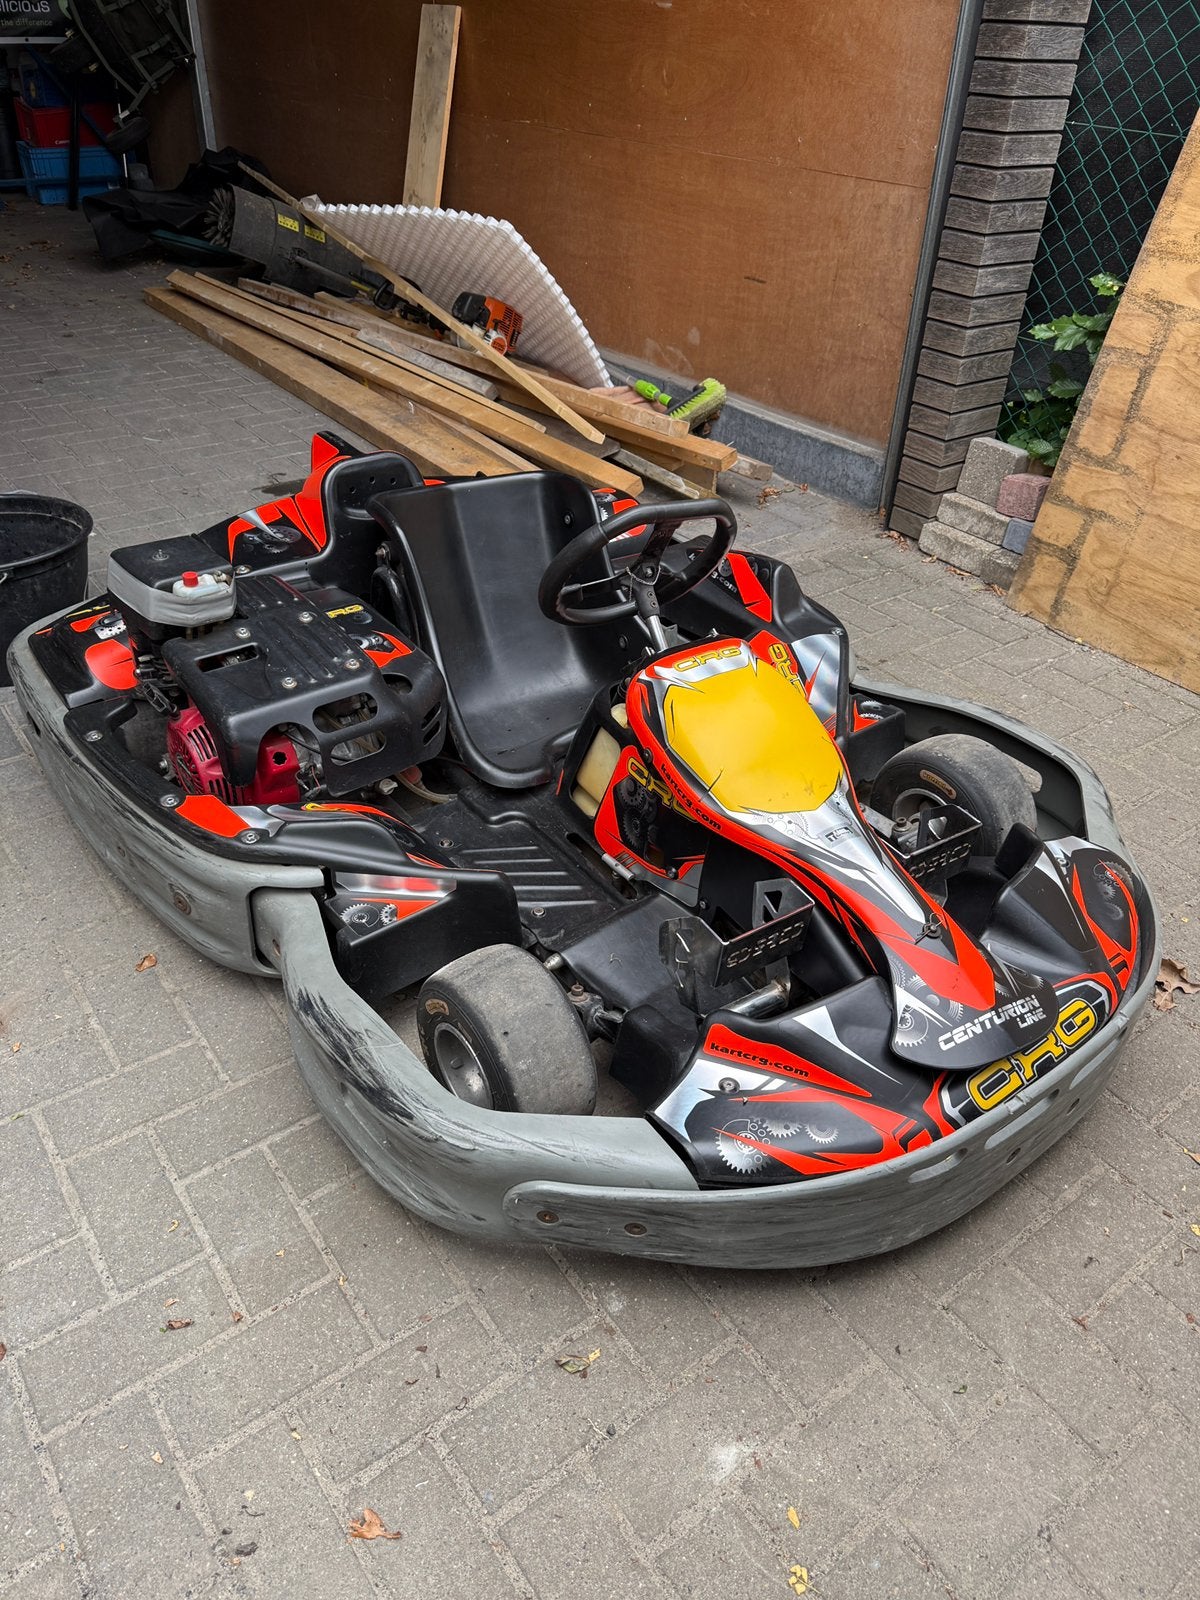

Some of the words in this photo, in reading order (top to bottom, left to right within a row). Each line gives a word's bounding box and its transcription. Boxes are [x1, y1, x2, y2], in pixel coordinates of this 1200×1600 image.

[0, 0, 50, 13] licious
[1, 18, 14, 26] the
[15, 18, 53, 27] difference
[325, 604, 365, 619] RG
[673, 646, 742, 673] CRG
[660, 763, 723, 831] kartcrg.com
[937, 994, 1041, 1052] CENTURION
[1016, 1007, 1047, 1029] LINE
[709, 1042, 810, 1078] kartcrg.com
[966, 1007, 1098, 1112] CRG
